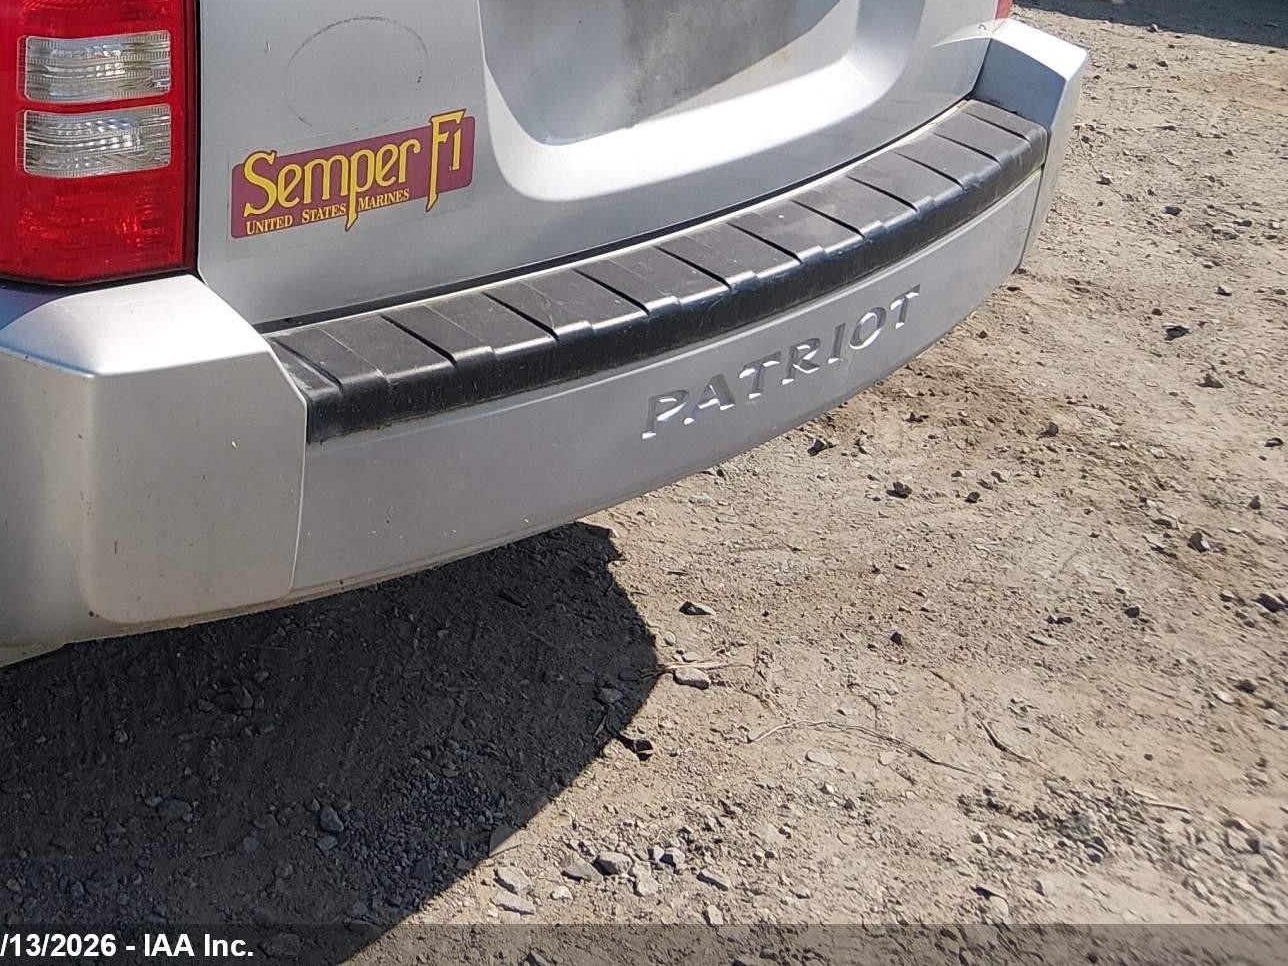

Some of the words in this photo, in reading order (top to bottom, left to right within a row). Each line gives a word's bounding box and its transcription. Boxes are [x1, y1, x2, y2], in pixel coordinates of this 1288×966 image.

[242, 149, 421, 232] Semper
[425, 108, 466, 212] Fi
[245, 214, 294, 235] UNITED
[301, 202, 348, 224] STATES
[357, 188, 410, 212] MARINES
[642, 284, 920, 439] PATRIOT
